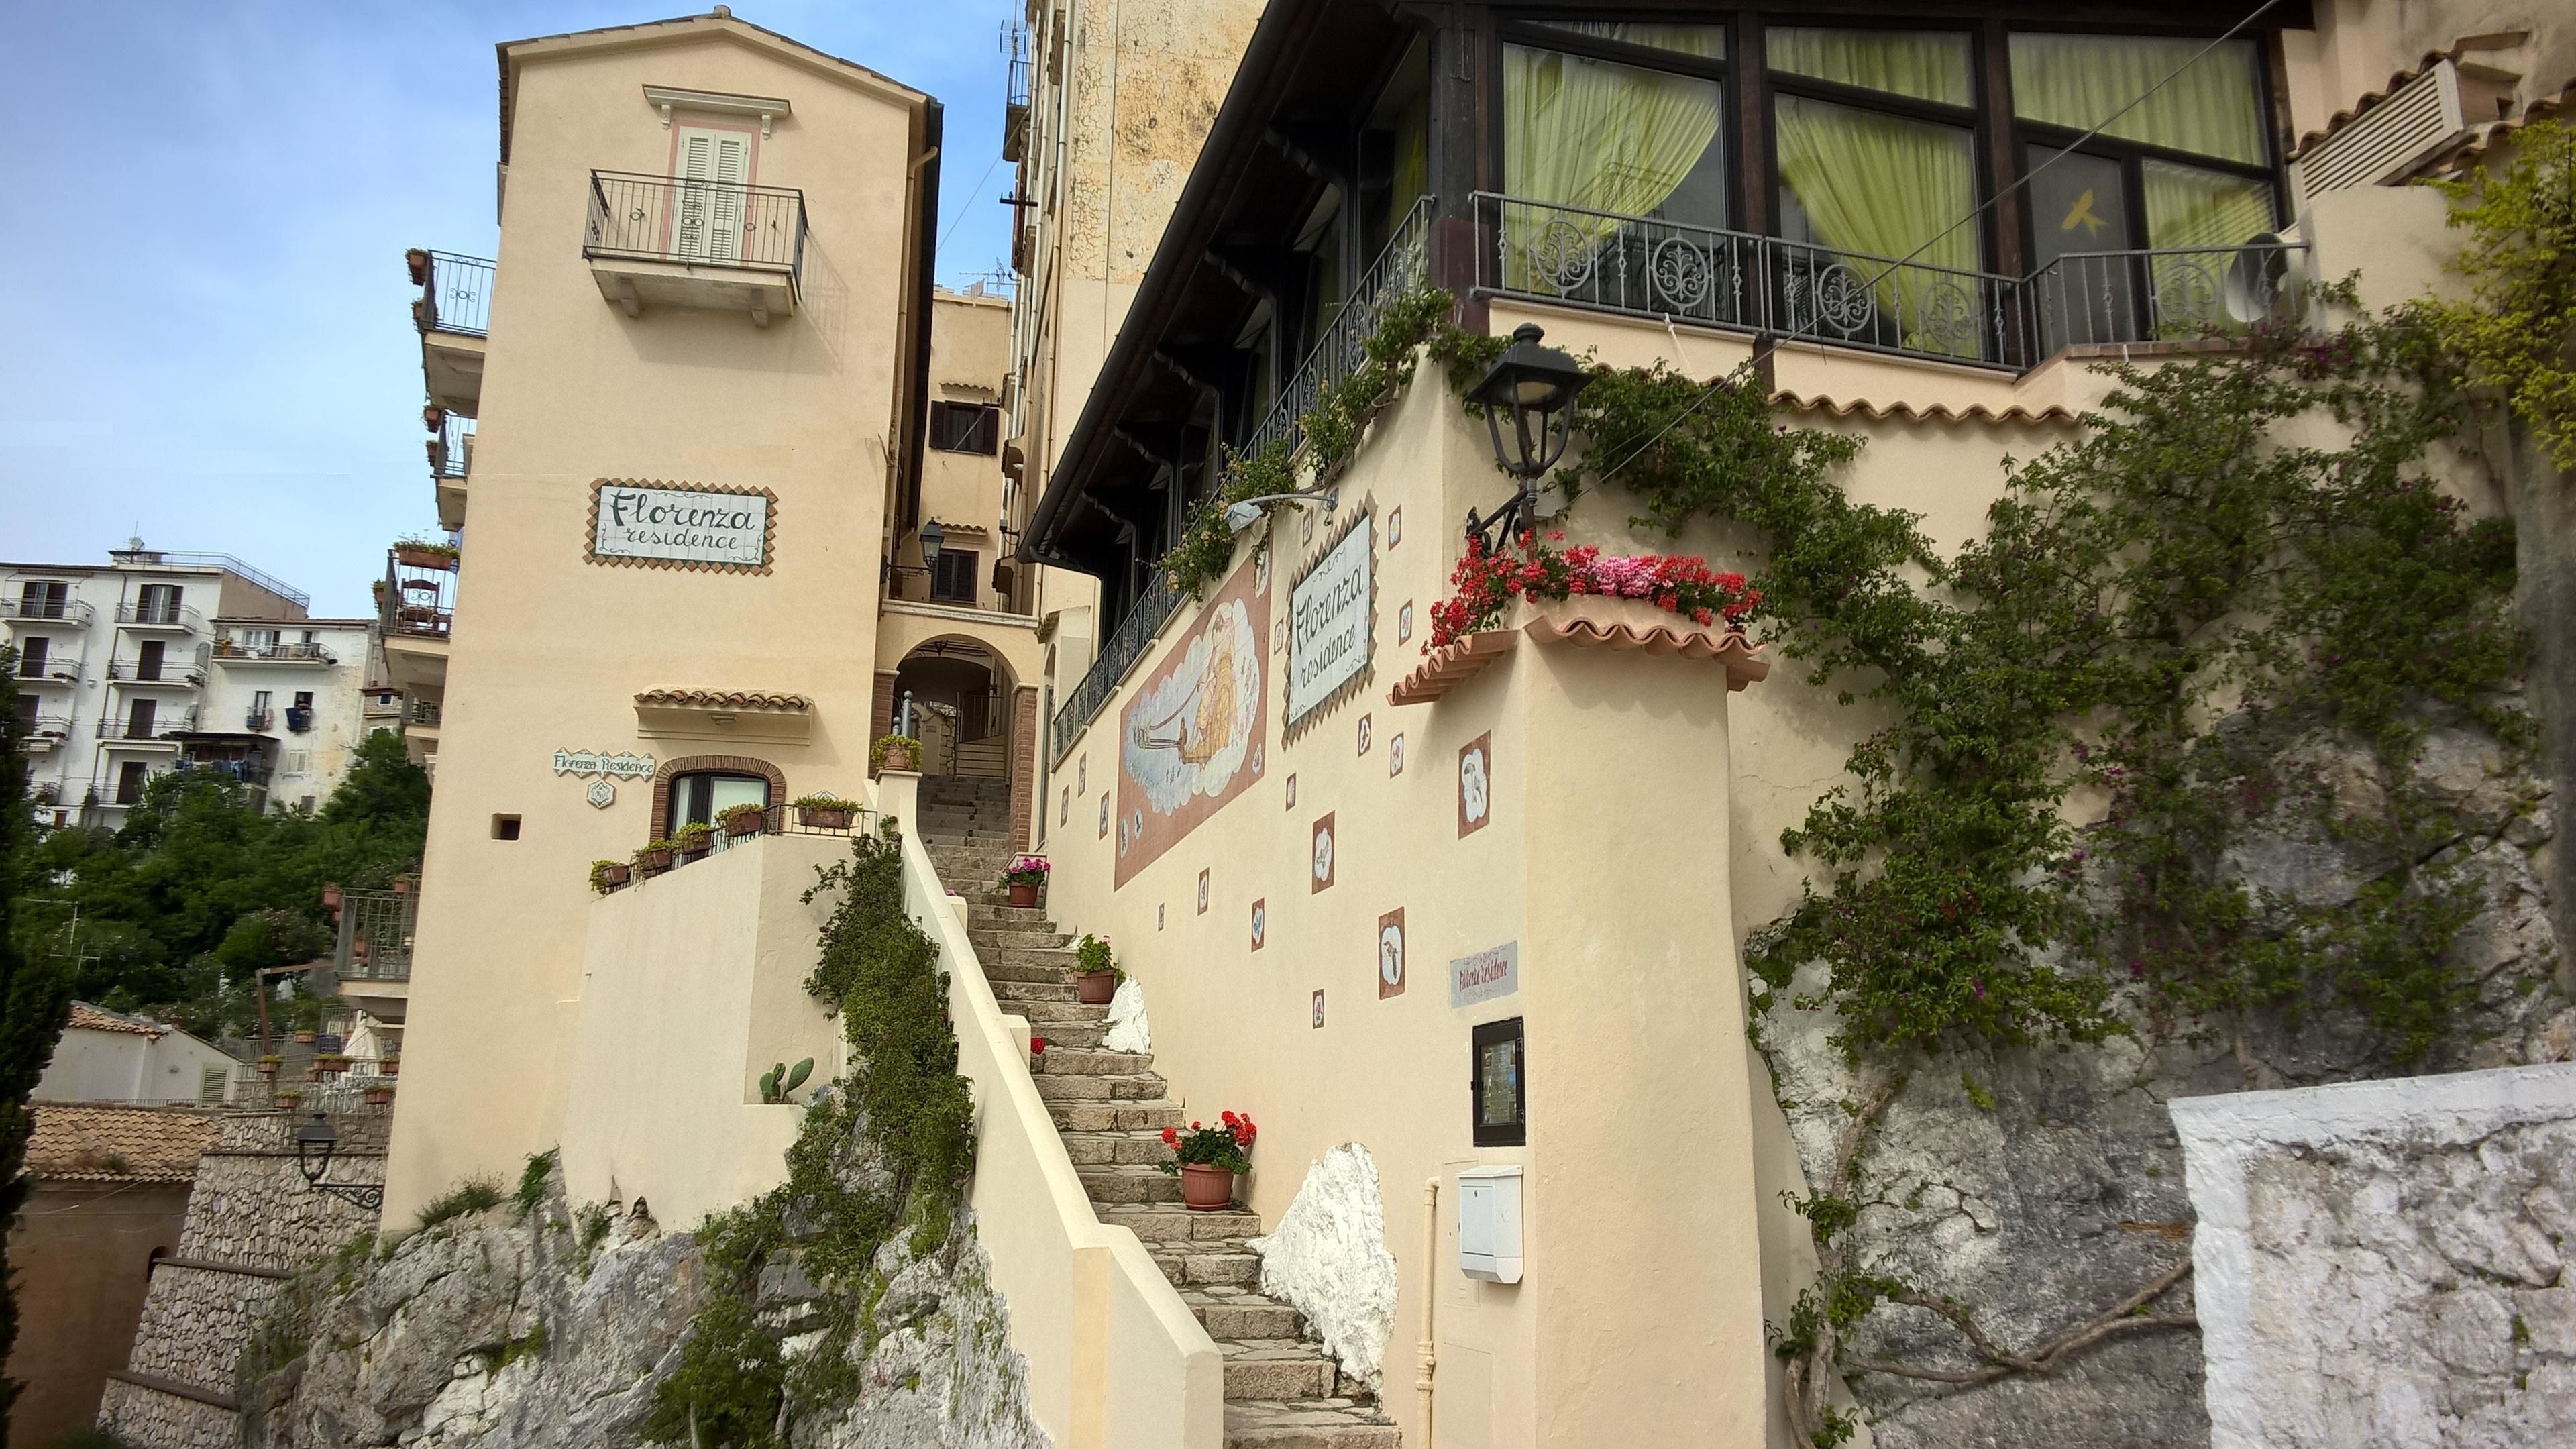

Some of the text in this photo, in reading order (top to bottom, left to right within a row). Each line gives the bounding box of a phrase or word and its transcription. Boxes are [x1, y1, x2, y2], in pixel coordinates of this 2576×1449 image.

[610, 489, 755, 530] Florenza
[623, 528, 738, 549] residence
[1296, 564, 1364, 656] Florenza
[1300, 623, 1356, 689] residence
[554, 755, 653, 772] Florenza Residence
